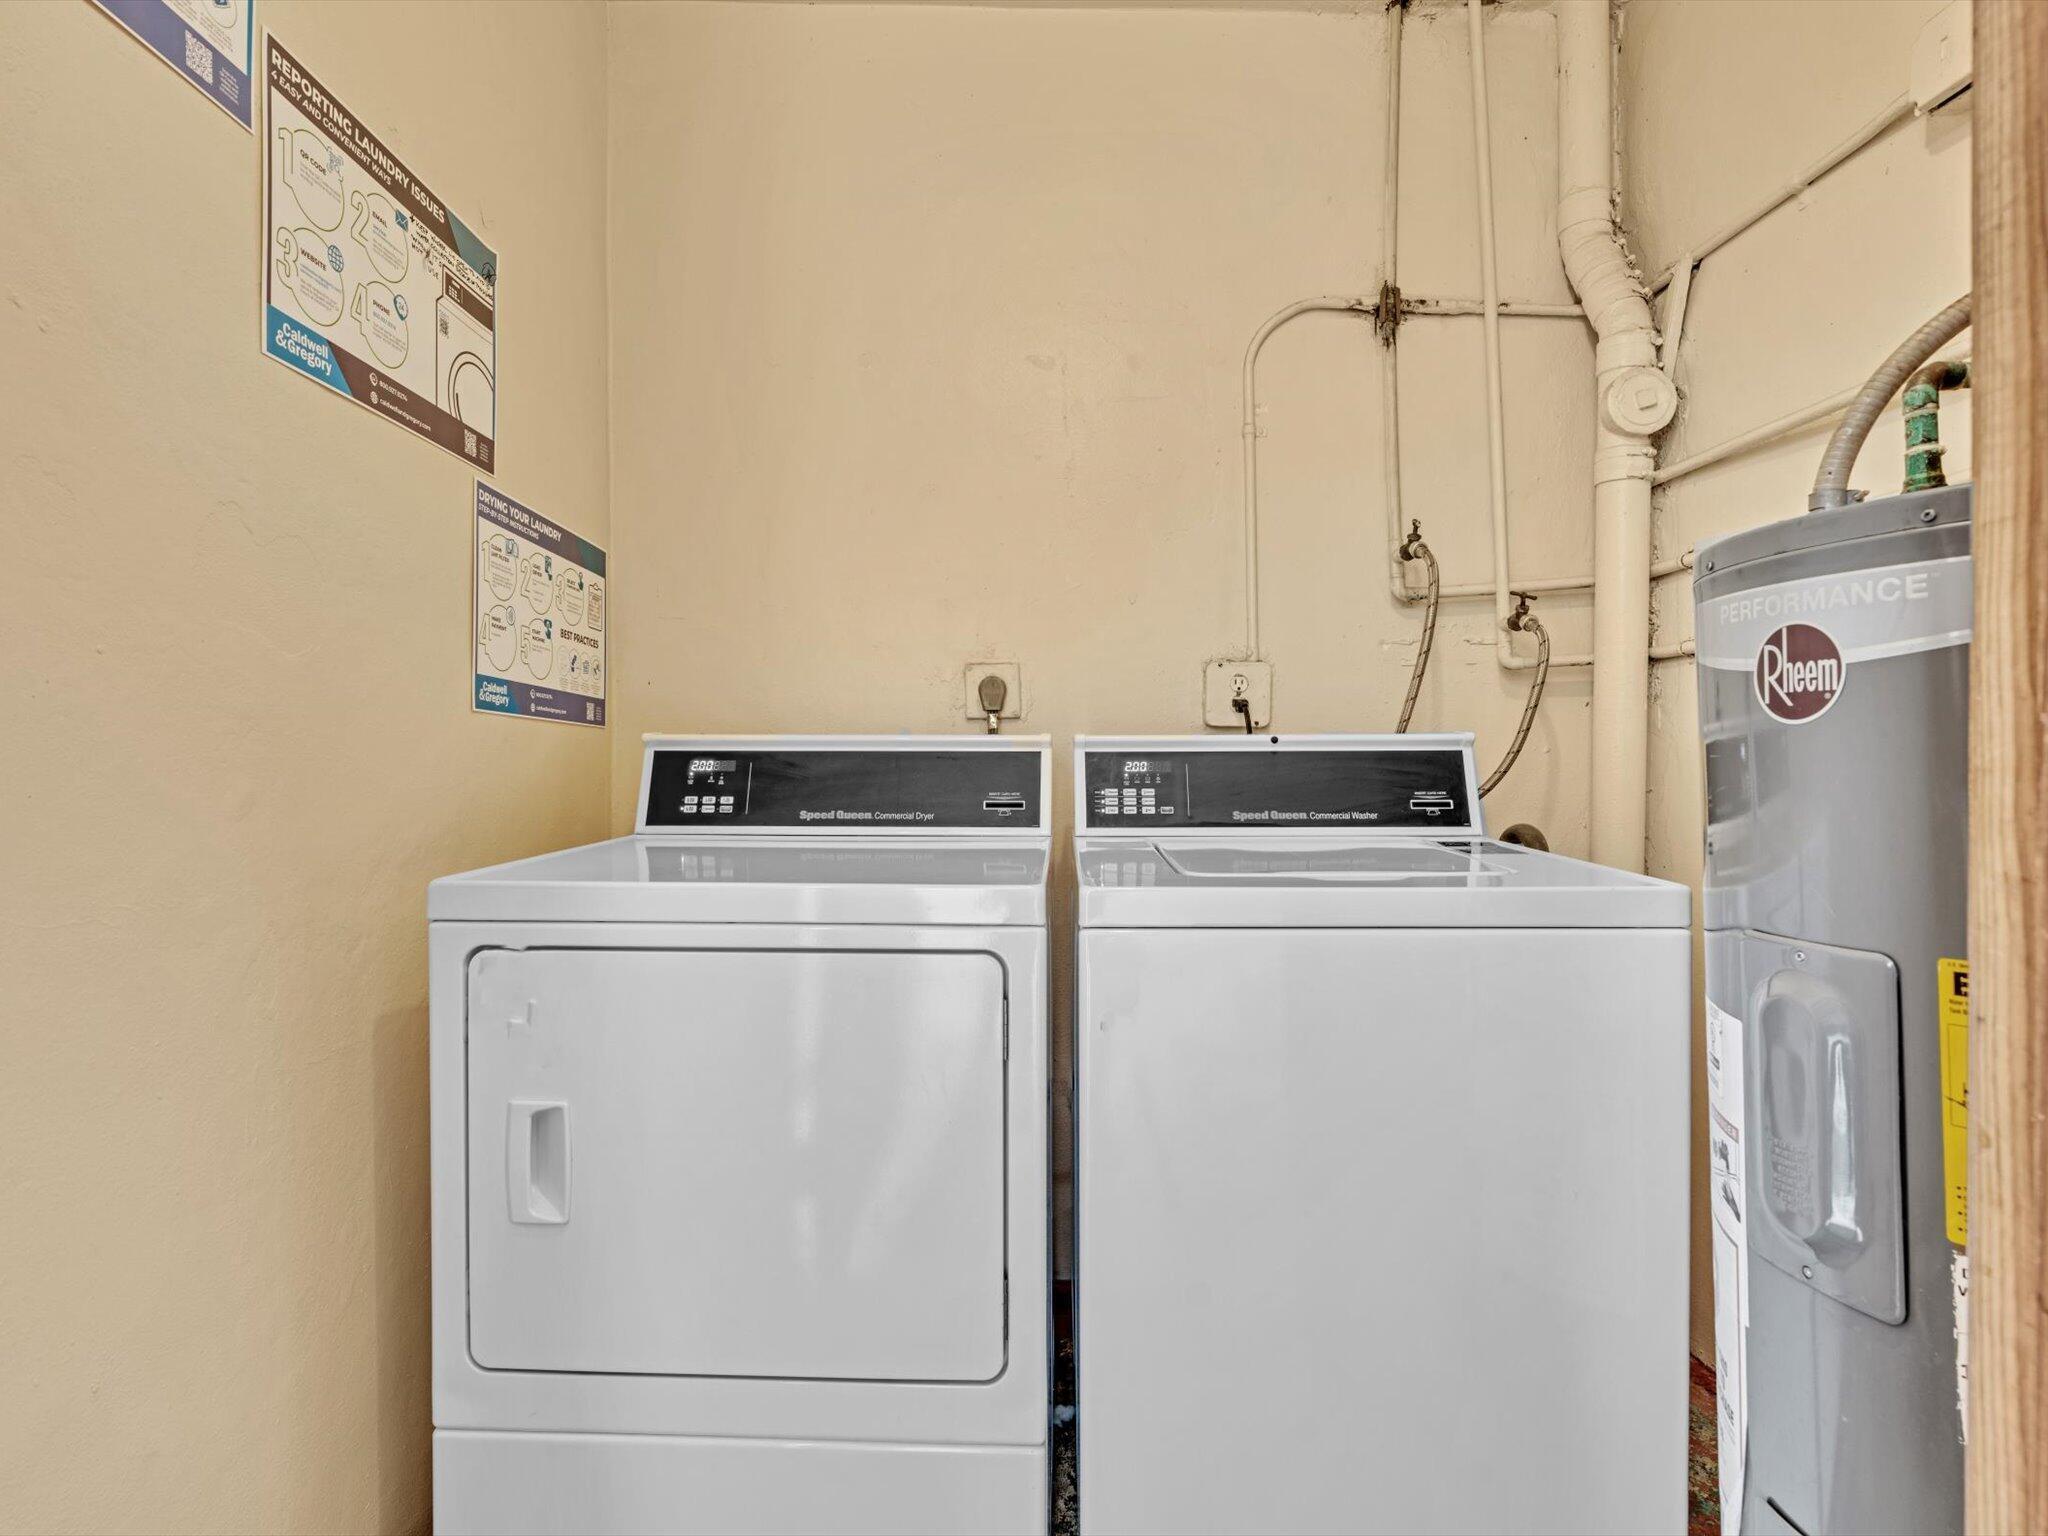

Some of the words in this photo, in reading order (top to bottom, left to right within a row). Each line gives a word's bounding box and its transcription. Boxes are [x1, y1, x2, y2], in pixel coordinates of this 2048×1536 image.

[271, 70, 278, 80] 4
[279, 76, 302, 101] EASY
[302, 99, 322, 120] AND
[322, 117, 370, 166] CONVENIENT
[371, 161, 392, 186] WAYS
[271, 47, 352, 136] REPORTING
[355, 127, 410, 189] LAUNDRY
[411, 182, 445, 224] ISSUES
[300, 148, 309, 161] QR
[309, 157, 327, 176] CODE
[300, 247, 327, 272] WEBSITE
[282, 322, 329, 360] Caldwell
[478, 488, 509, 514] DRYING
[509, 504, 530, 524] YOUR
[530, 516, 562, 542] LAUNDRY
[478, 502, 510, 524] STEP-BY-STEP
[509, 519, 540, 540] INSTRUCTIONS
[560, 628, 573, 641] BEST
[573, 632, 599, 649] PRACTICES
[1763, 626, 1838, 707] Rheem
[482, 681, 508, 696] Caldwell
[800, 810, 835, 821] Speed
[836, 810, 872, 820] Queen
[874, 811, 915, 820] Commercial
[915, 811, 935, 821] Dryer
[1232, 810, 1269, 822] Speed
[1270, 810, 1307, 820] Queen
[1309, 811, 1351, 820] Commercial
[1351, 811, 1378, 820] Washer
